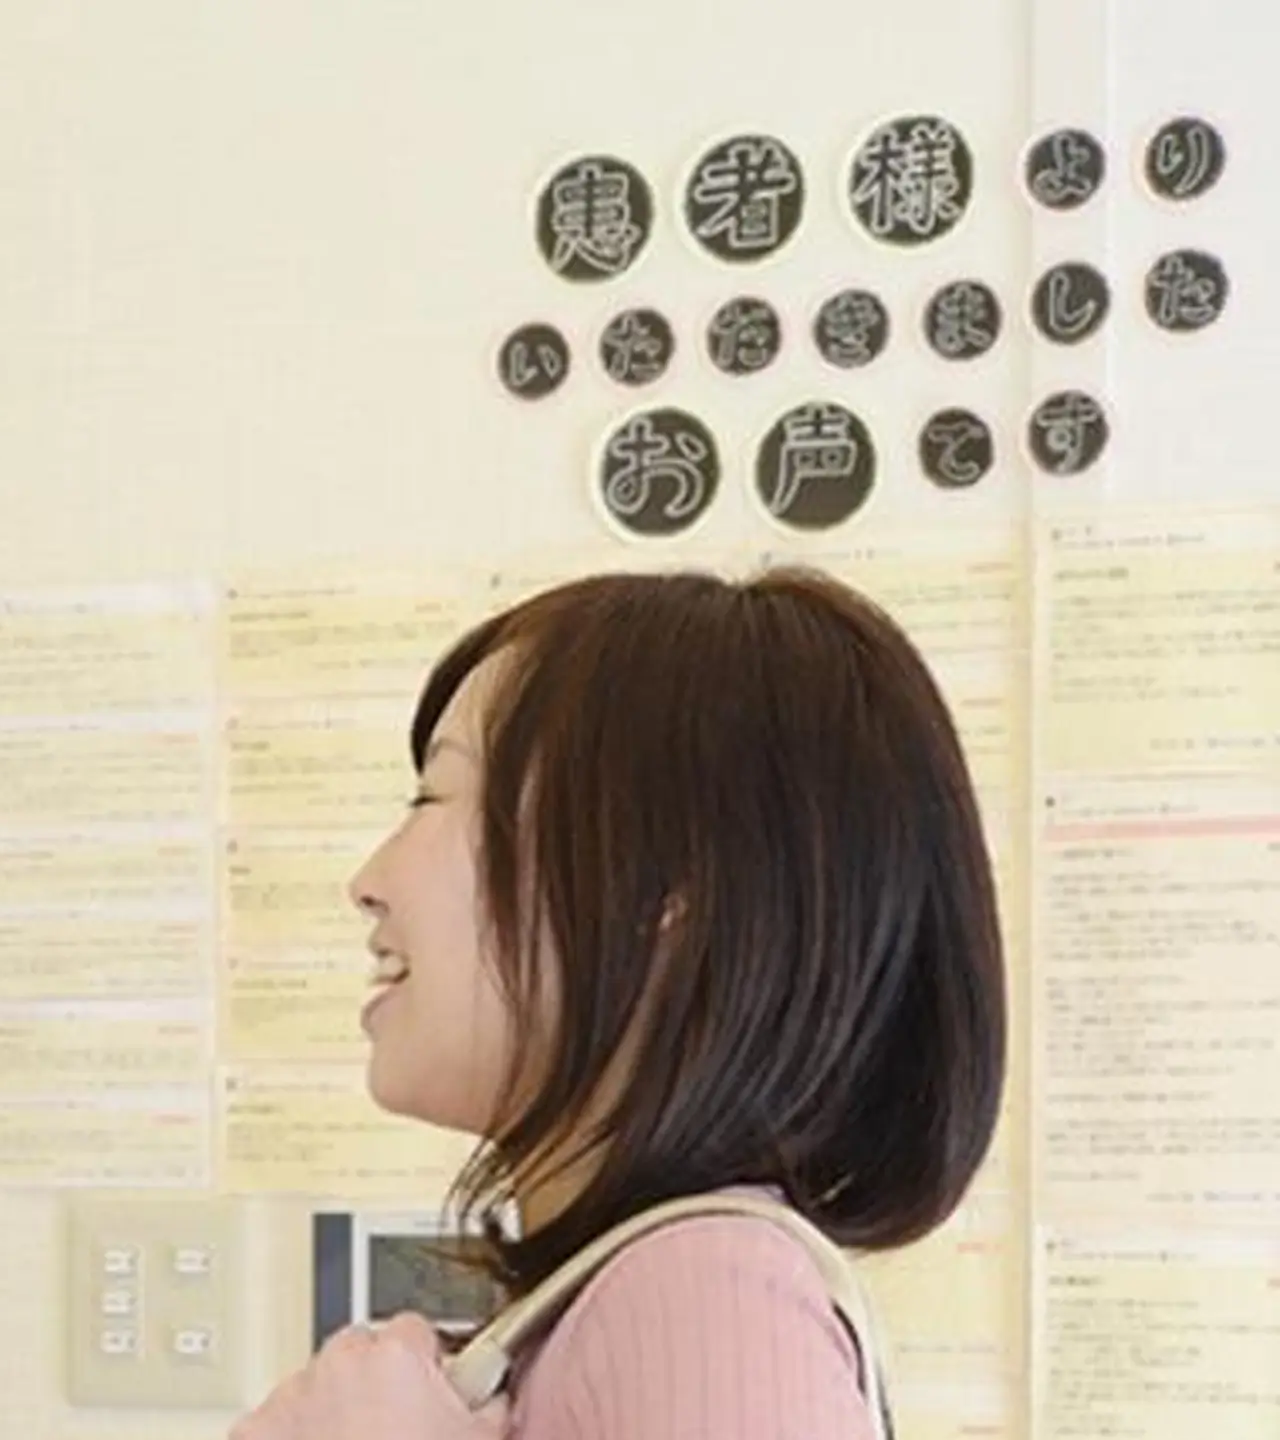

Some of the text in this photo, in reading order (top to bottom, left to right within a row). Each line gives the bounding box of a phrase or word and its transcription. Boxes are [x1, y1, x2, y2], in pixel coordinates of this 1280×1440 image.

[552, 120, 1208, 273] 患者様より
[509, 252, 1218, 386] いただきました
[605, 393, 1098, 518] お声です
